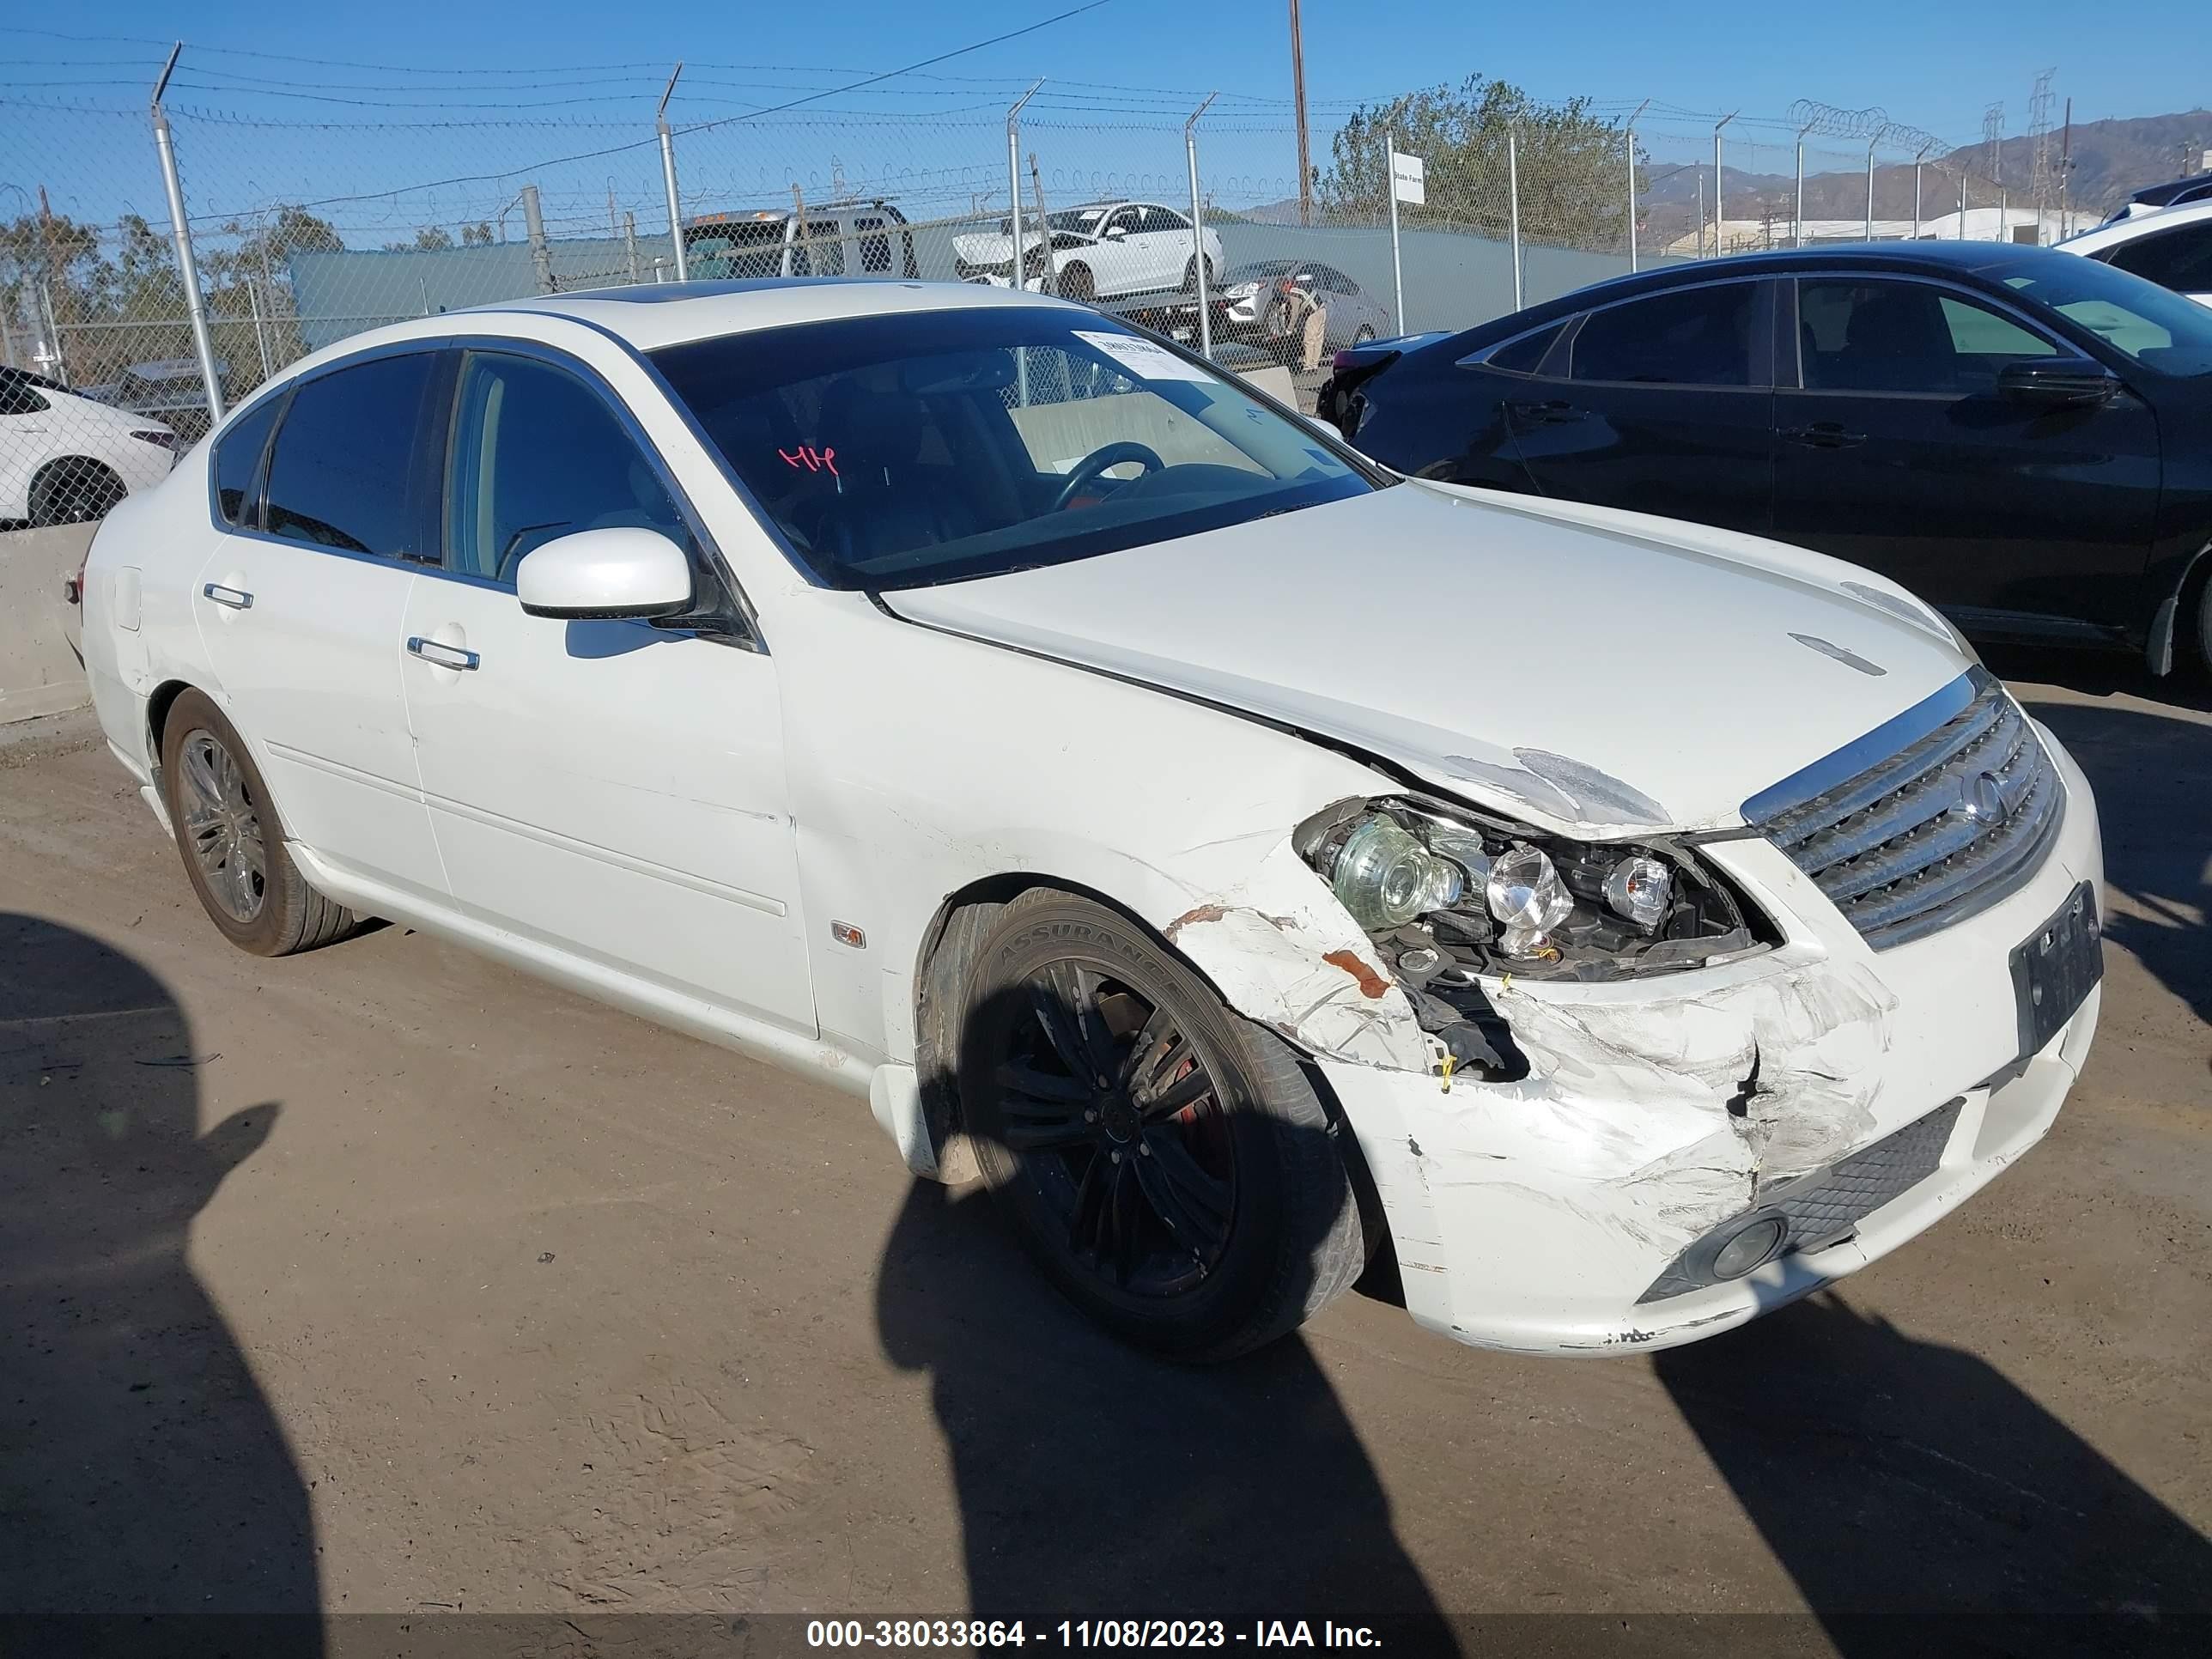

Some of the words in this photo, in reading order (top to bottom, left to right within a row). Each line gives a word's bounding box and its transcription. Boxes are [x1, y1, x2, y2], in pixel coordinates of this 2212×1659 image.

[1395, 171, 1408, 181] State
[1409, 174, 1422, 185] Farm
[1000, 922, 1190, 1002] ASSURANCE
